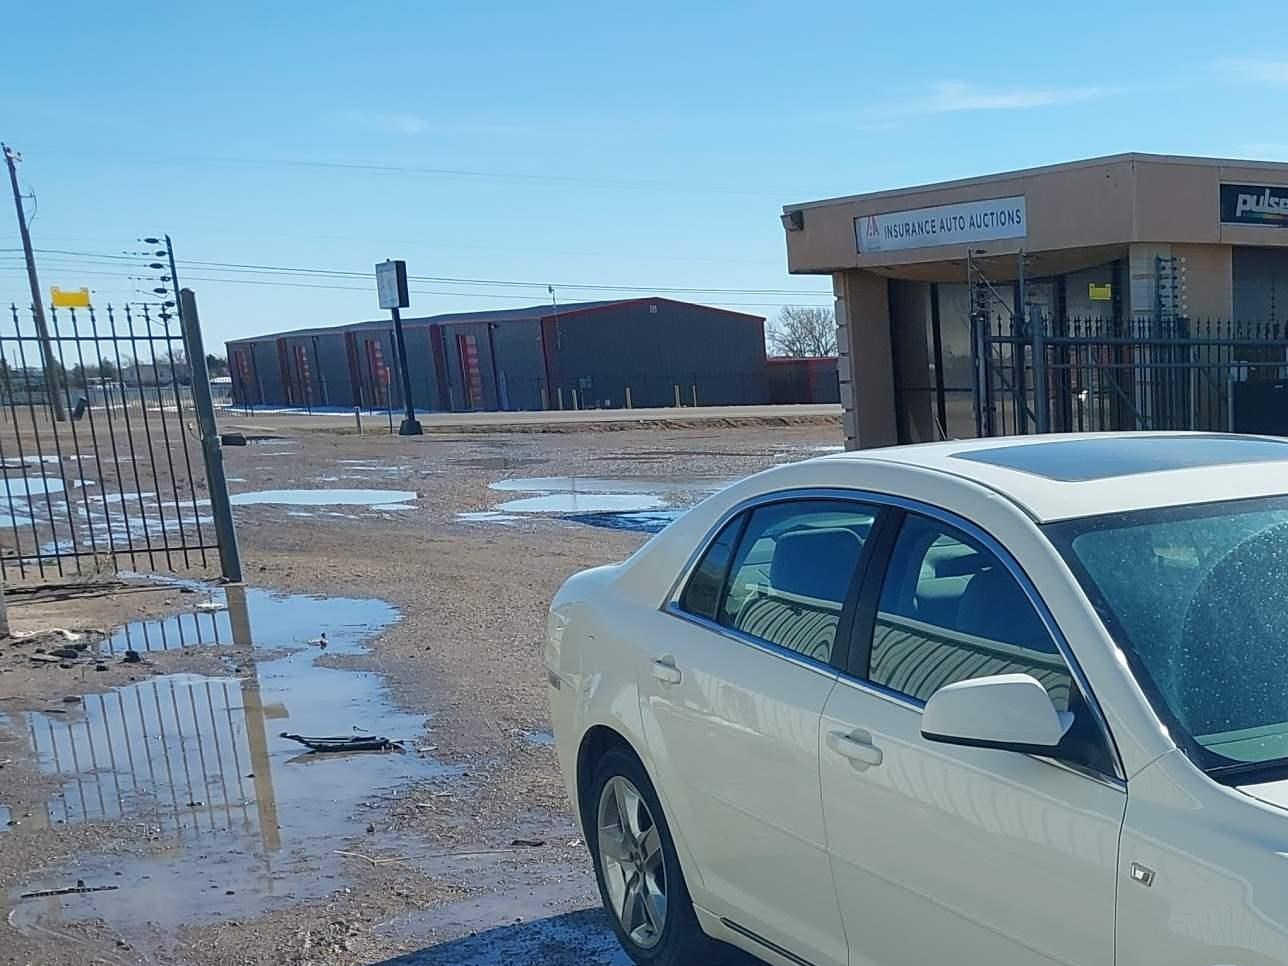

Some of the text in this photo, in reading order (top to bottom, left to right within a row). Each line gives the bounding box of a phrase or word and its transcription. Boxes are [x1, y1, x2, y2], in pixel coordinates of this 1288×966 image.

[884, 219, 936, 239] INSURANCE
[940, 215, 965, 232] AUTO
[969, 208, 1021, 229] AUCTIONS
